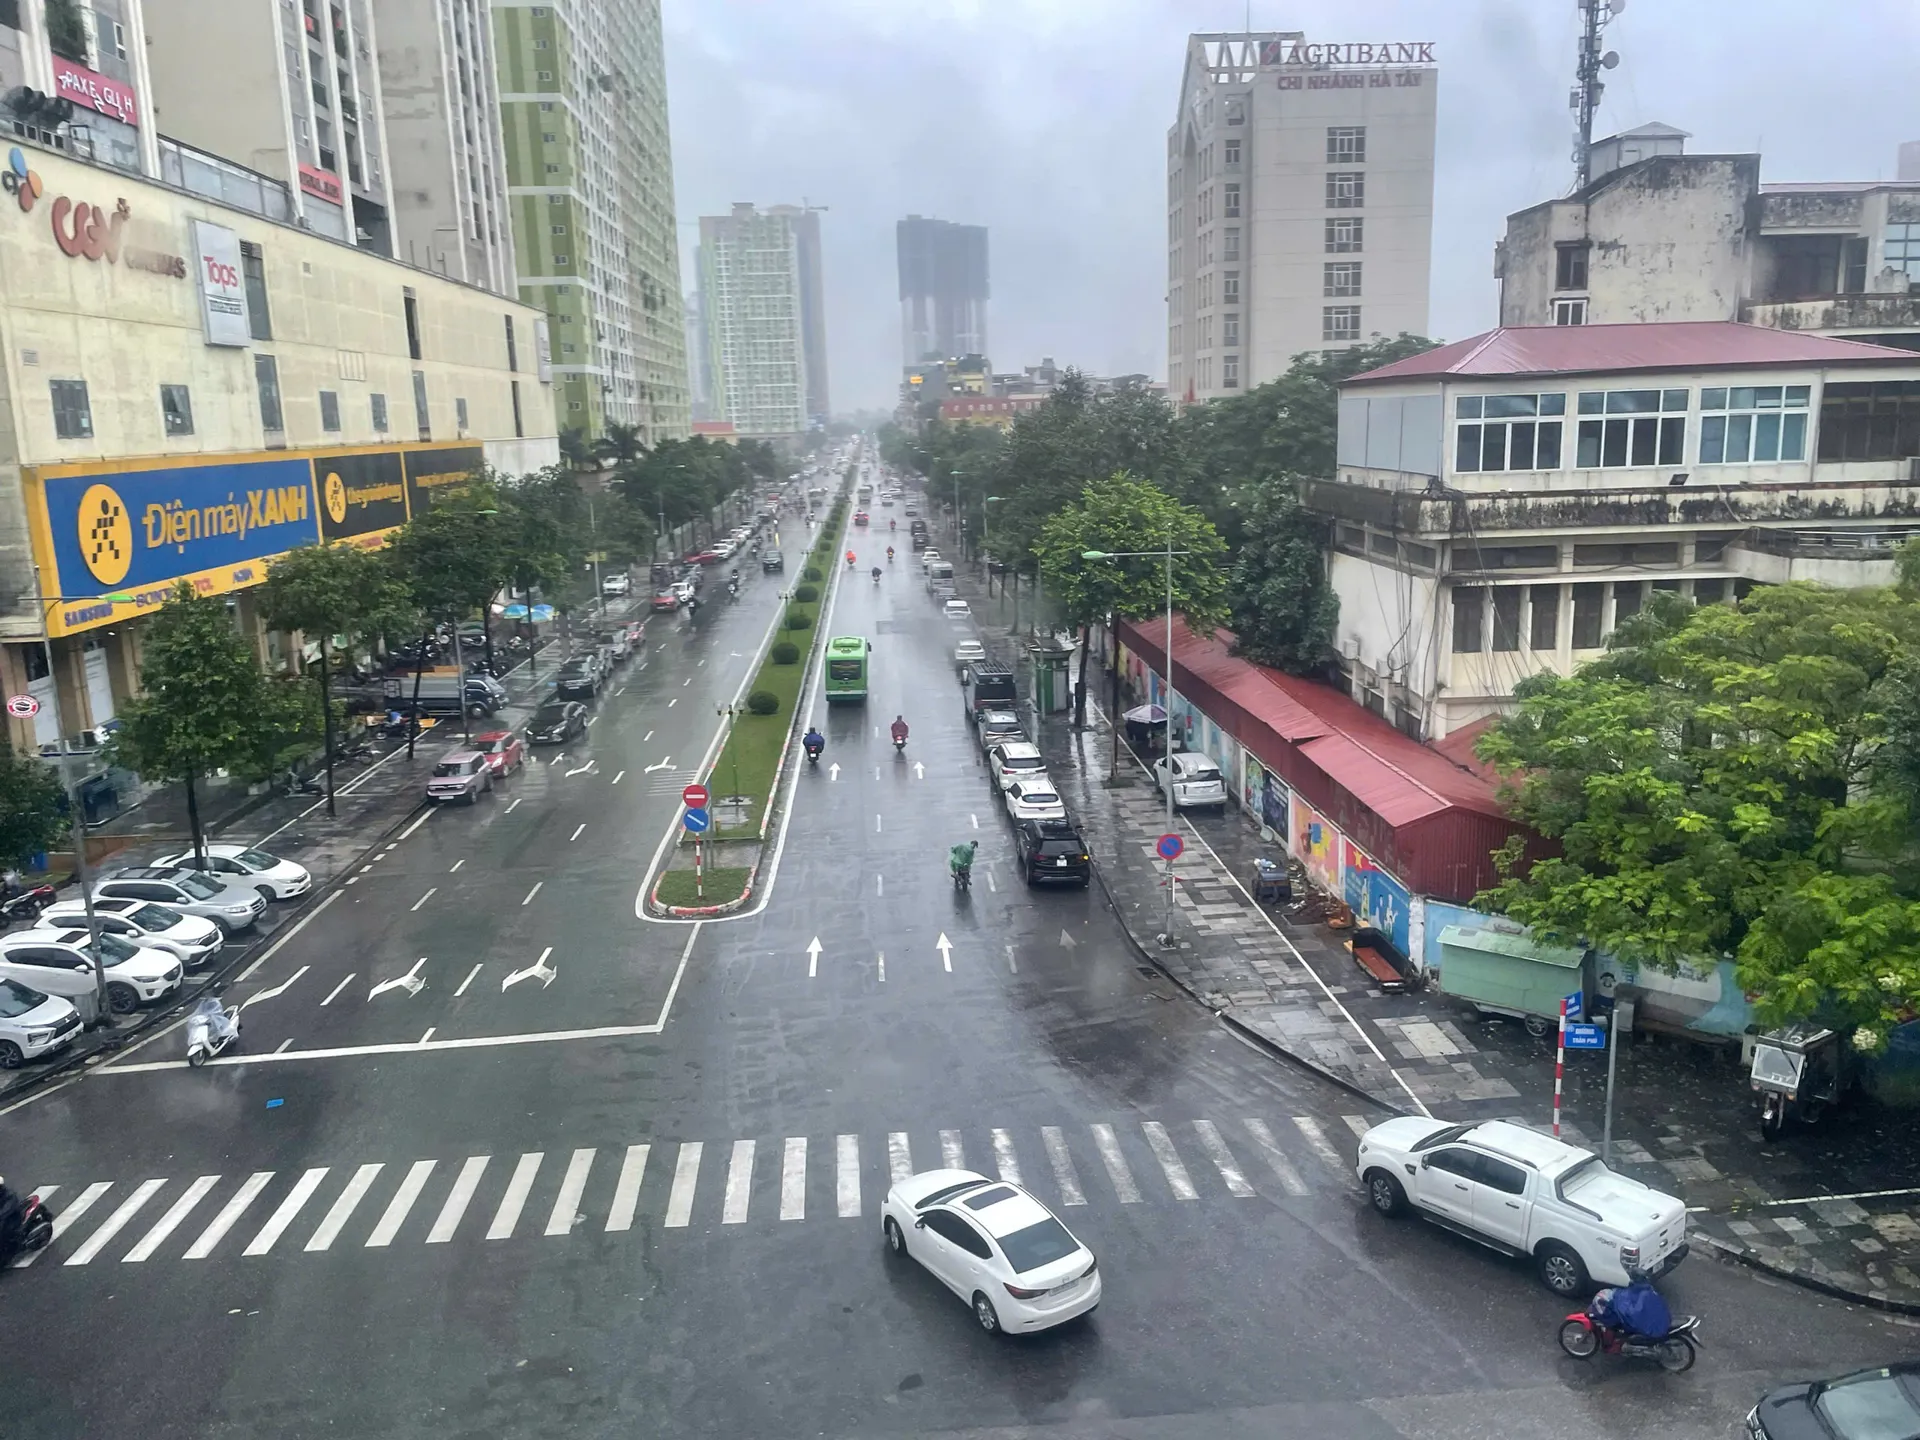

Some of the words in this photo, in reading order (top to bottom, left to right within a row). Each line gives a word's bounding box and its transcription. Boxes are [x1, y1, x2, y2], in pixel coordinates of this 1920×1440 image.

[1284, 42, 1437, 65] AGRIBANK
[1277, 75, 1303, 90] CHI
[1307, 70, 1365, 90] NHÁNH
[1369, 67, 1391, 88] HÀ
[203, 255, 238, 293] Tops
[142, 498, 201, 554] Điện
[64, 602, 113, 627] SAMSUNG
